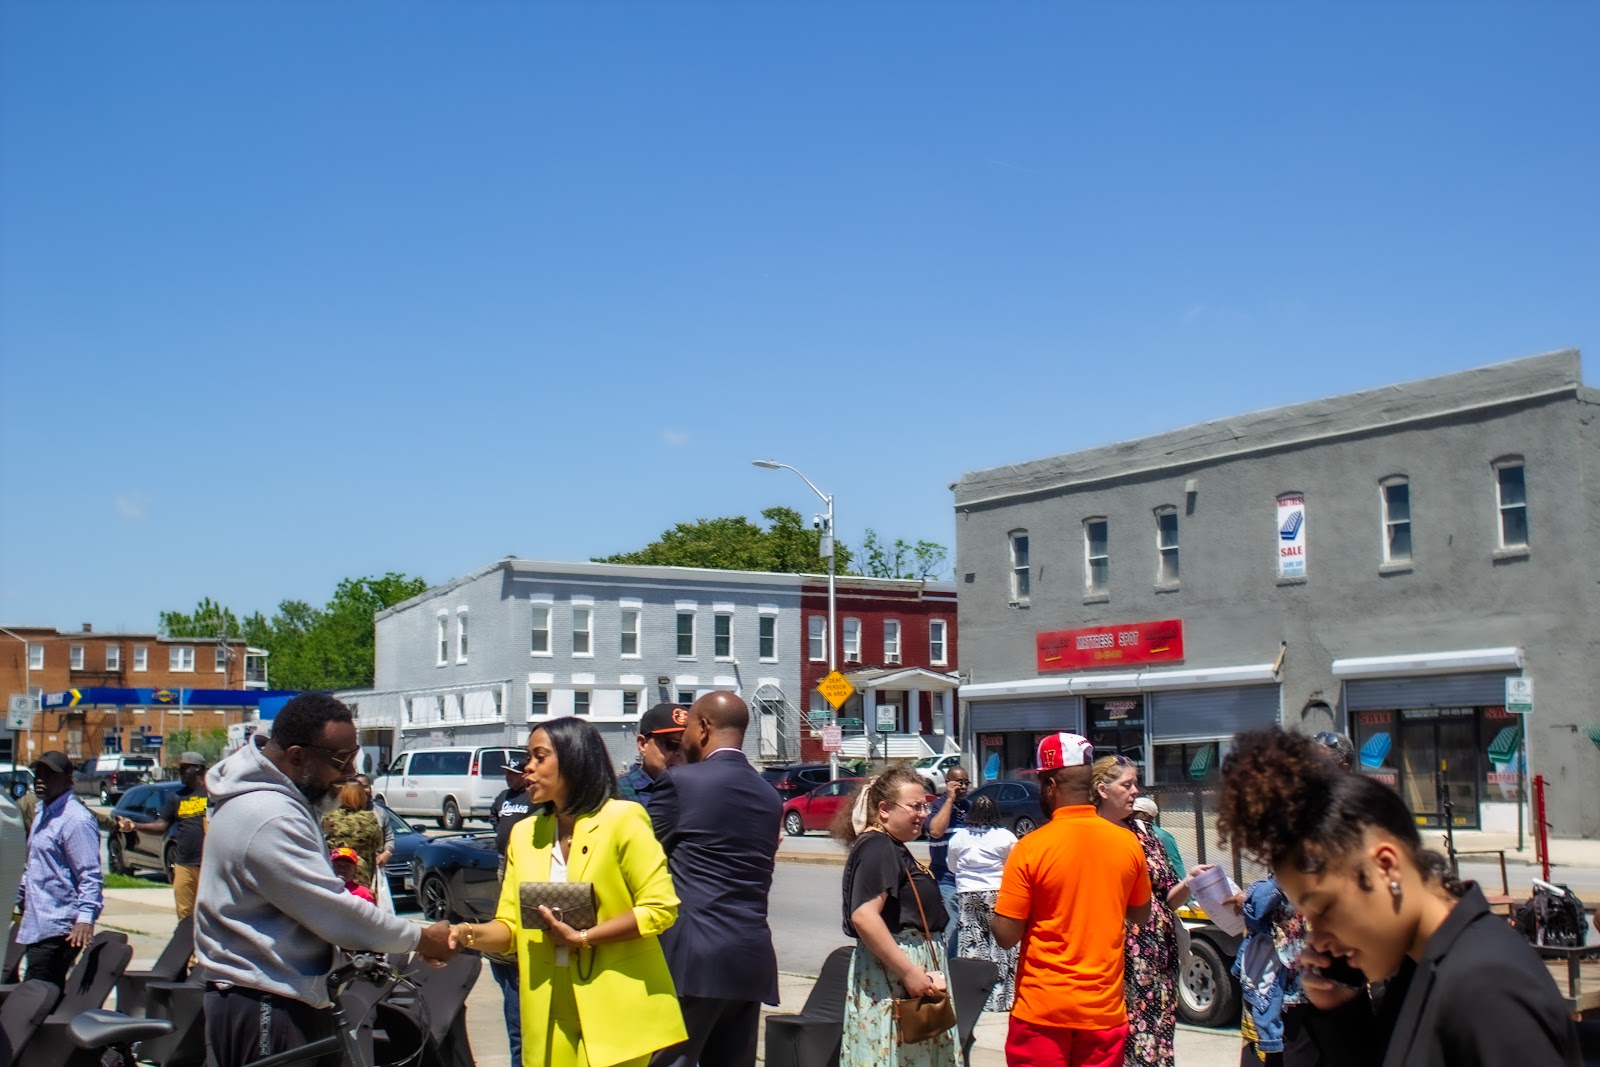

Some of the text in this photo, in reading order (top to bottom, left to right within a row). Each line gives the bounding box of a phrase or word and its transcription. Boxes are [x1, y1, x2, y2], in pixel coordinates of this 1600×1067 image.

[1281, 546, 1303, 557] SALE
[1076, 633, 1114, 650] MATTRESS
[1118, 631, 1139, 647] SPOT
[1359, 711, 1391, 724] SALE
